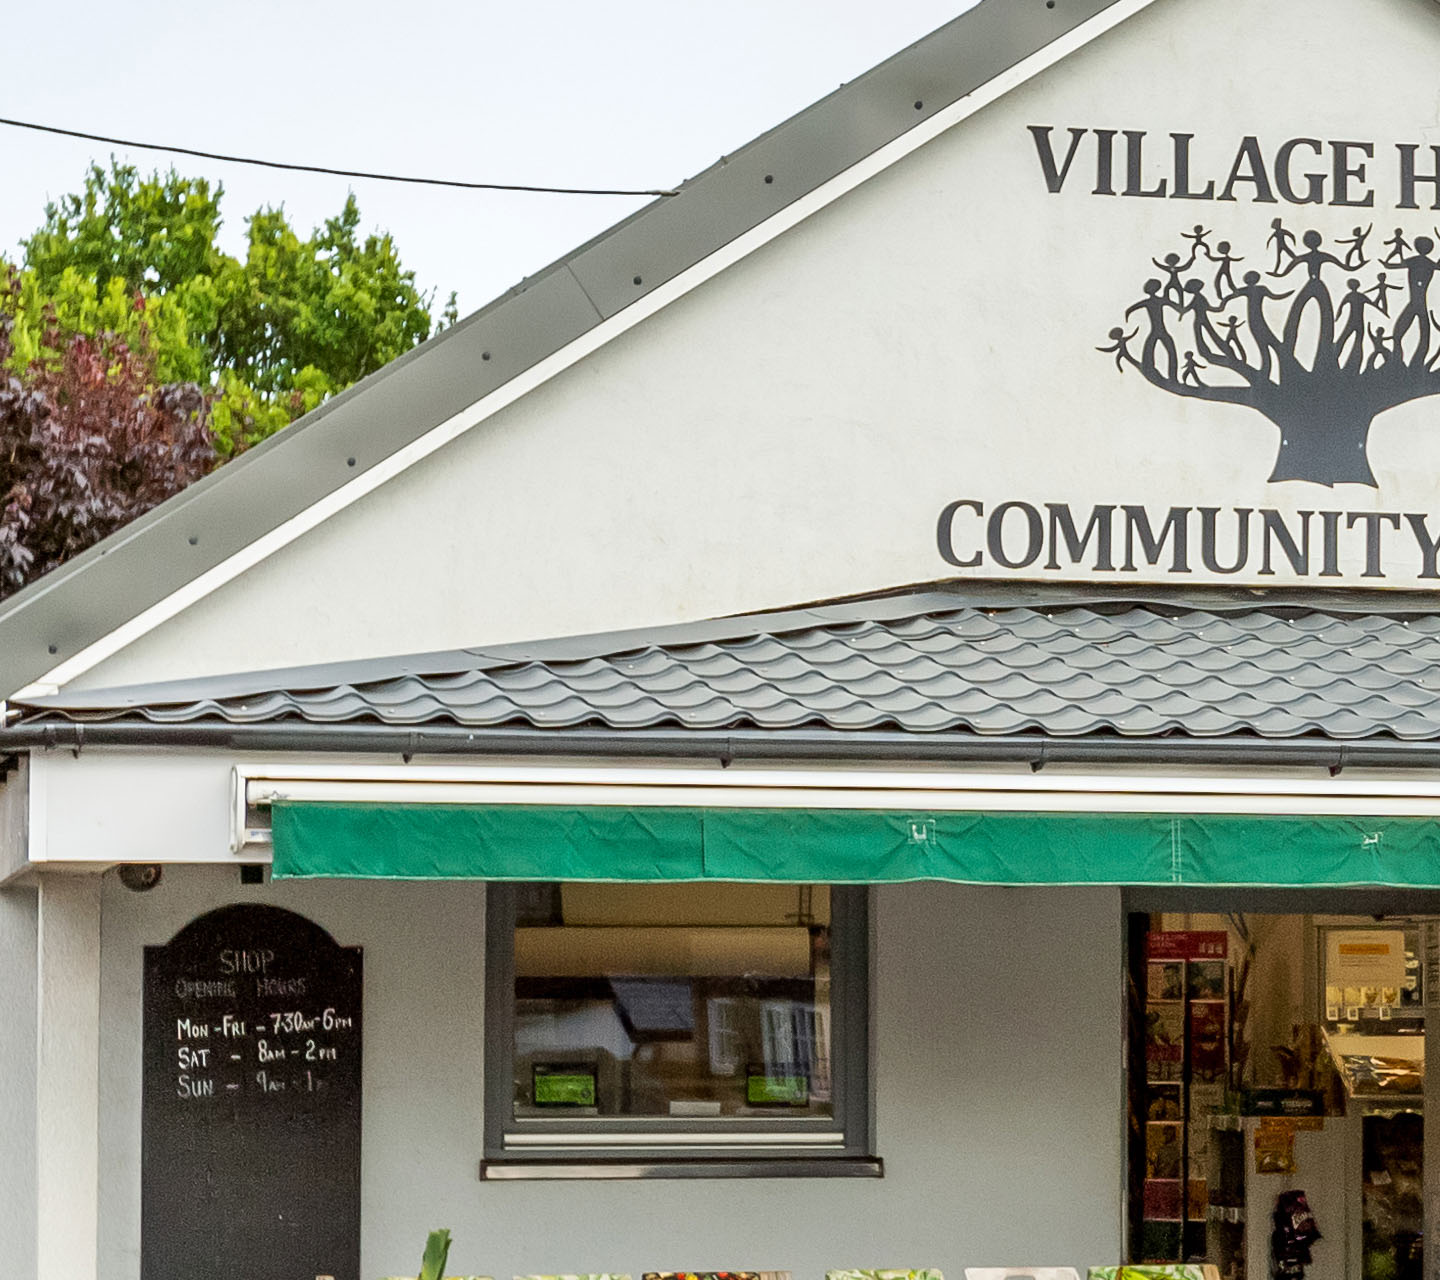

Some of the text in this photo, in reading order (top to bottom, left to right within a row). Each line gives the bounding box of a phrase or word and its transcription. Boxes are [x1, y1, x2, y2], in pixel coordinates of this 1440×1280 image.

[1027, 125, 1375, 208] VILLAGE
[220, 949, 274, 974] SHOP
[178, 1047, 211, 1069] SAT
[176, 1074, 214, 1098] SUN
